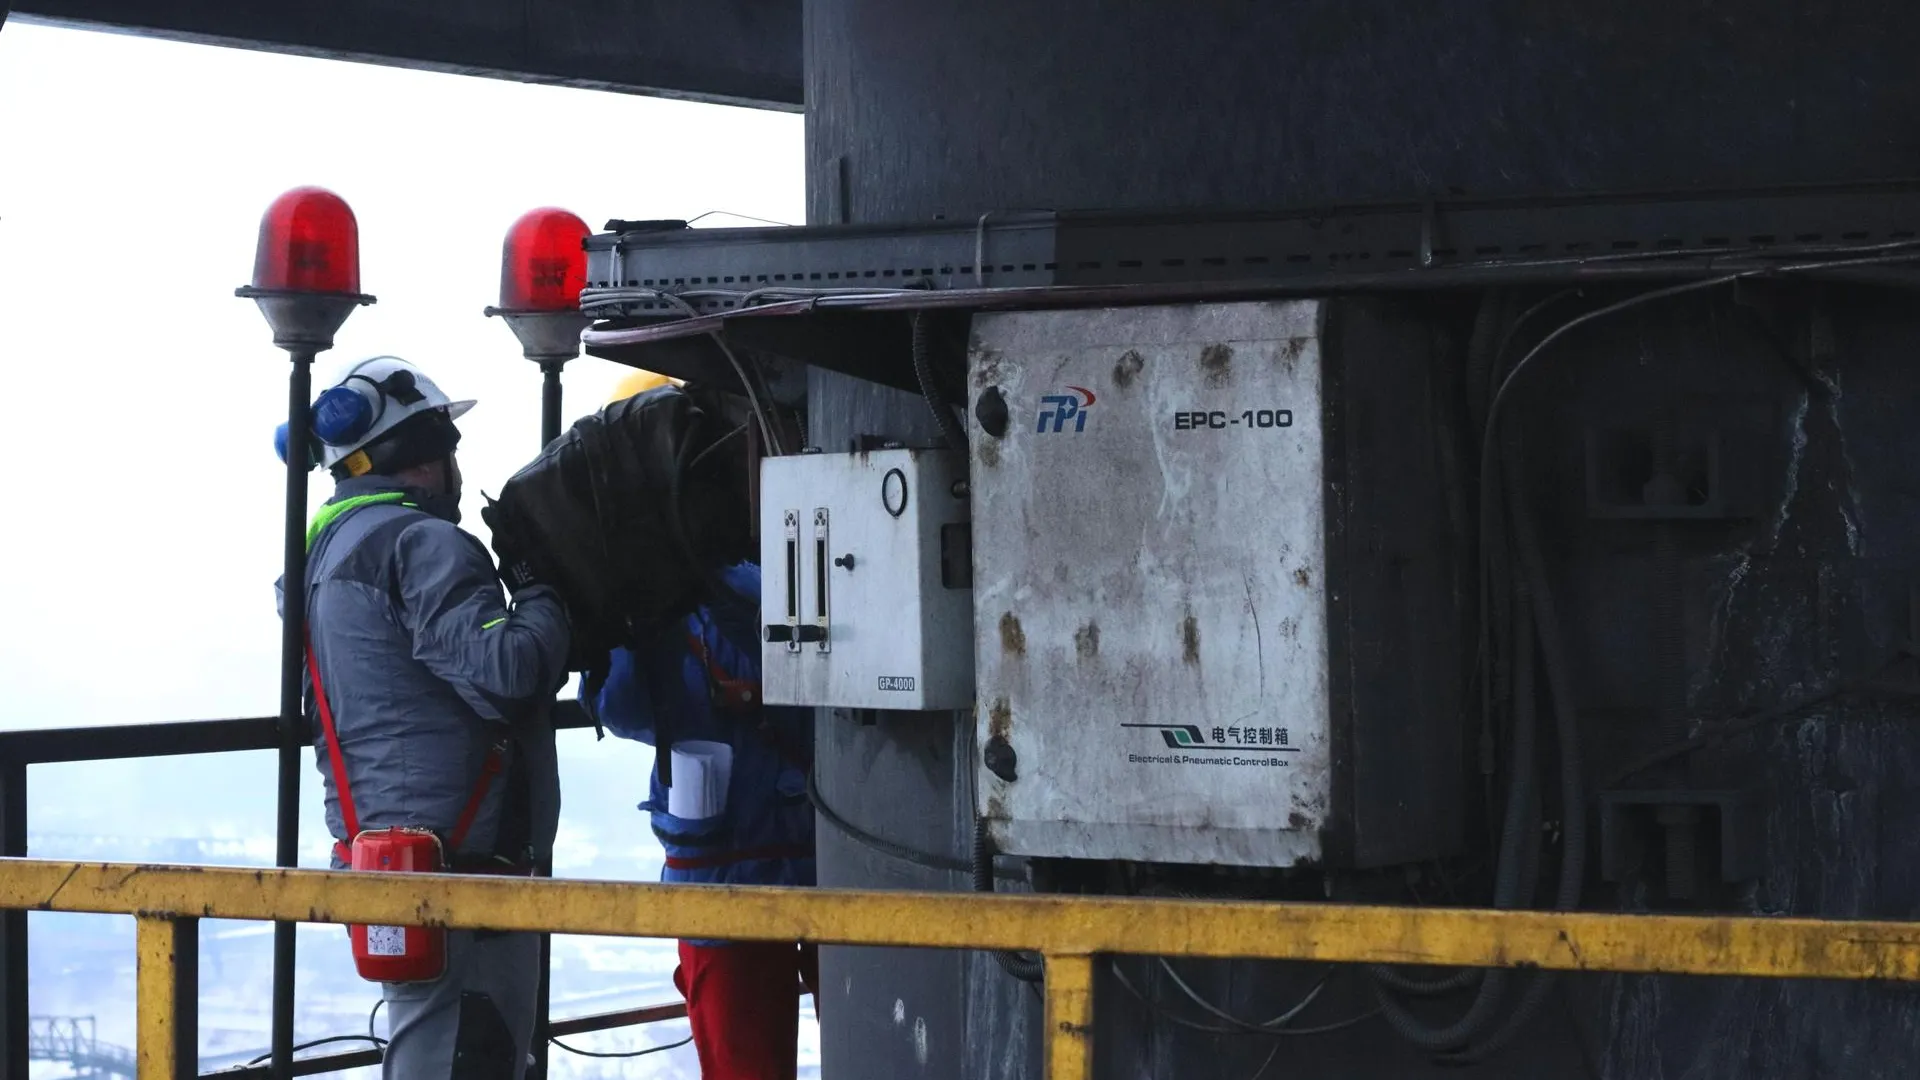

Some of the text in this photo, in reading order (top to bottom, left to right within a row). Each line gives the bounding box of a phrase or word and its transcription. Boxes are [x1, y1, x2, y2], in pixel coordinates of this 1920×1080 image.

[1174, 409, 1293, 430] EPC-100
[879, 677, 914, 690] GP-4000
[1212, 726, 1289, 745] 电气控制箱
[1128, 754, 1289, 767] Electrical & Pneumatic Control Box
